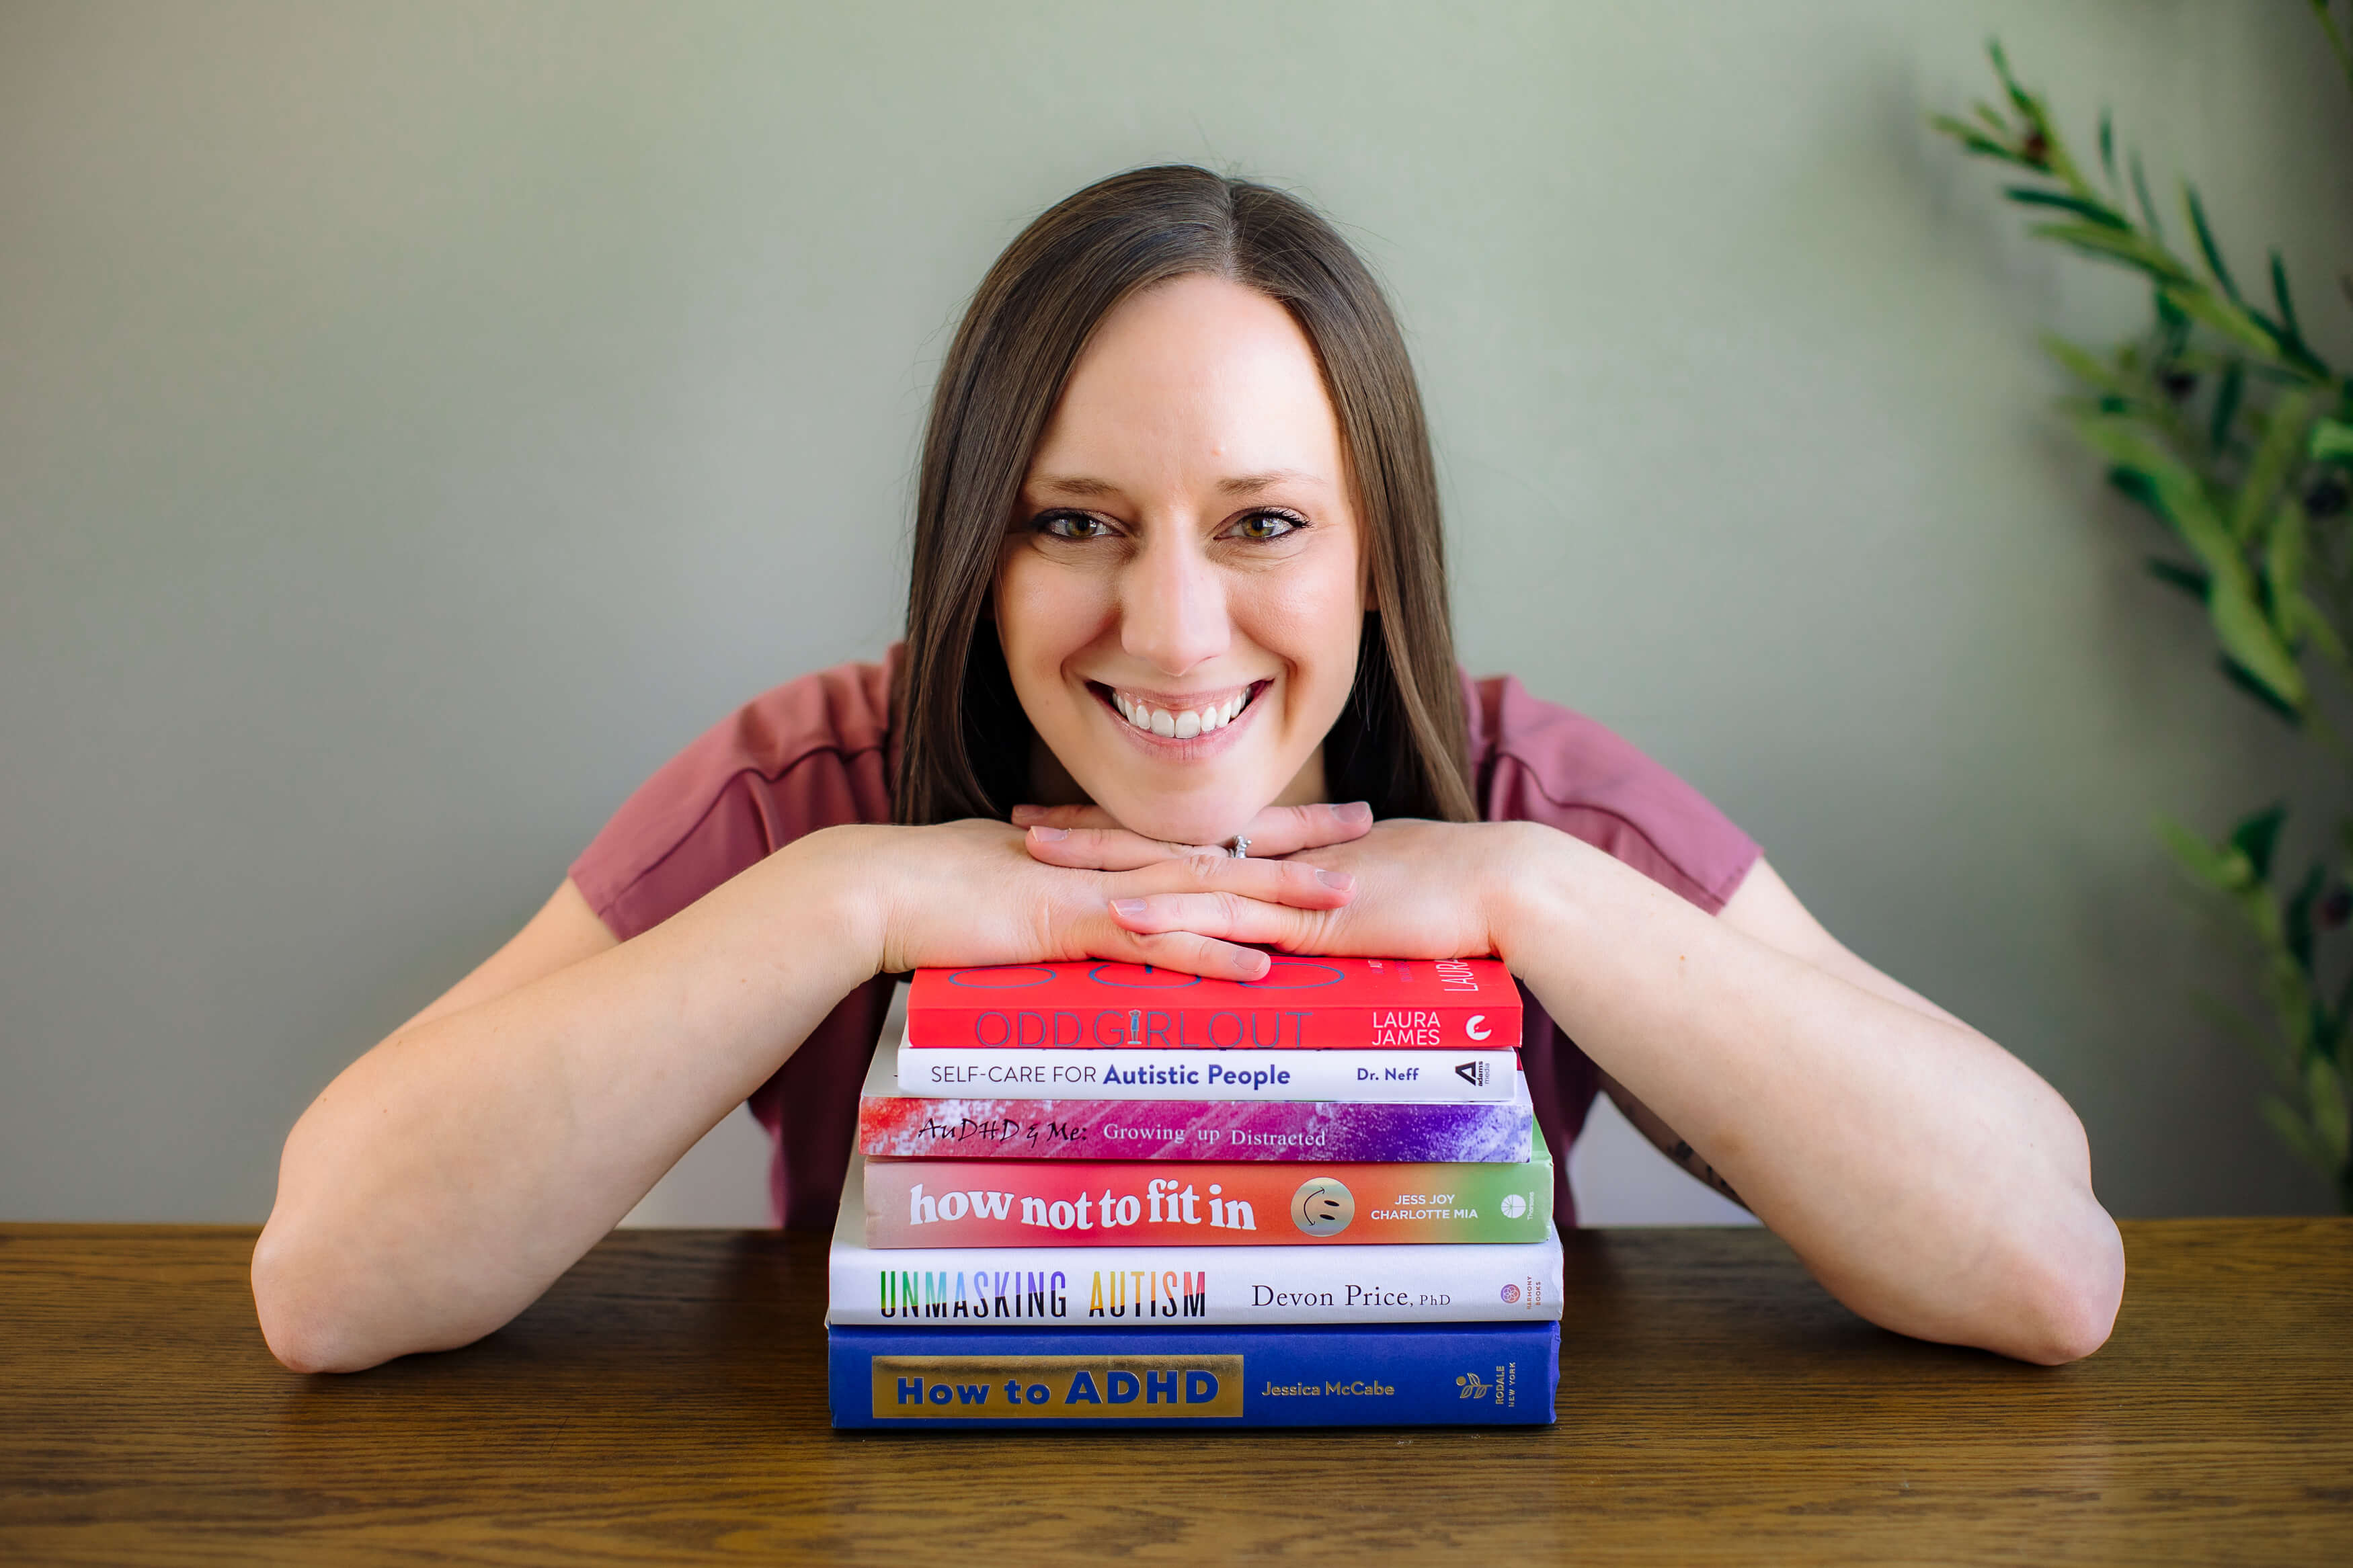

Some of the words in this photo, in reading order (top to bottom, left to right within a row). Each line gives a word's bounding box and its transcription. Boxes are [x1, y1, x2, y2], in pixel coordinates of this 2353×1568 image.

[976, 1012, 1082, 1048] ODD
[1208, 1012, 1313, 1048] OUT
[1372, 1012, 1441, 1029] LAURA
[1371, 1029, 1440, 1046] JAMES
[931, 1066, 1046, 1083] SELF-CARE
[1053, 1067, 1096, 1083] FOR
[1103, 1064, 1199, 1085] Autistic
[1209, 1064, 1290, 1090] People
[1357, 1068, 1379, 1081] Dr.
[1385, 1067, 1419, 1081] Neff
[918, 1118, 1019, 1143] AuDHD
[1027, 1123, 1039, 1148] &
[1046, 1122, 1087, 1141] Me:
[1103, 1123, 1185, 1143] Growing
[1197, 1129, 1220, 1144] up
[1231, 1130, 1326, 1147] Distracted
[910, 1184, 1014, 1226] how
[1021, 1192, 1093, 1230] not
[1099, 1189, 1141, 1228] to
[1146, 1178, 1202, 1224] fit
[1209, 1184, 1257, 1231] in
[1394, 1194, 1426, 1205] JESS
[1429, 1194, 1455, 1205] JOY
[1371, 1209, 1450, 1220] CHARLOTTE
[1454, 1209, 1478, 1219] MIA
[880, 1270, 1067, 1319] UNMASKING
[1089, 1270, 1206, 1318] AUTISM
[1251, 1284, 1333, 1307] Devon
[1345, 1284, 1413, 1308] Price,
[1419, 1294, 1451, 1306] PhD
[897, 1377, 990, 1405] How
[1004, 1380, 1050, 1405] to
[1065, 1370, 1220, 1405] ADHD
[1262, 1382, 1320, 1397] Jessica
[1326, 1380, 1395, 1396] McCabe
[1496, 1366, 1505, 1405] RODALE
